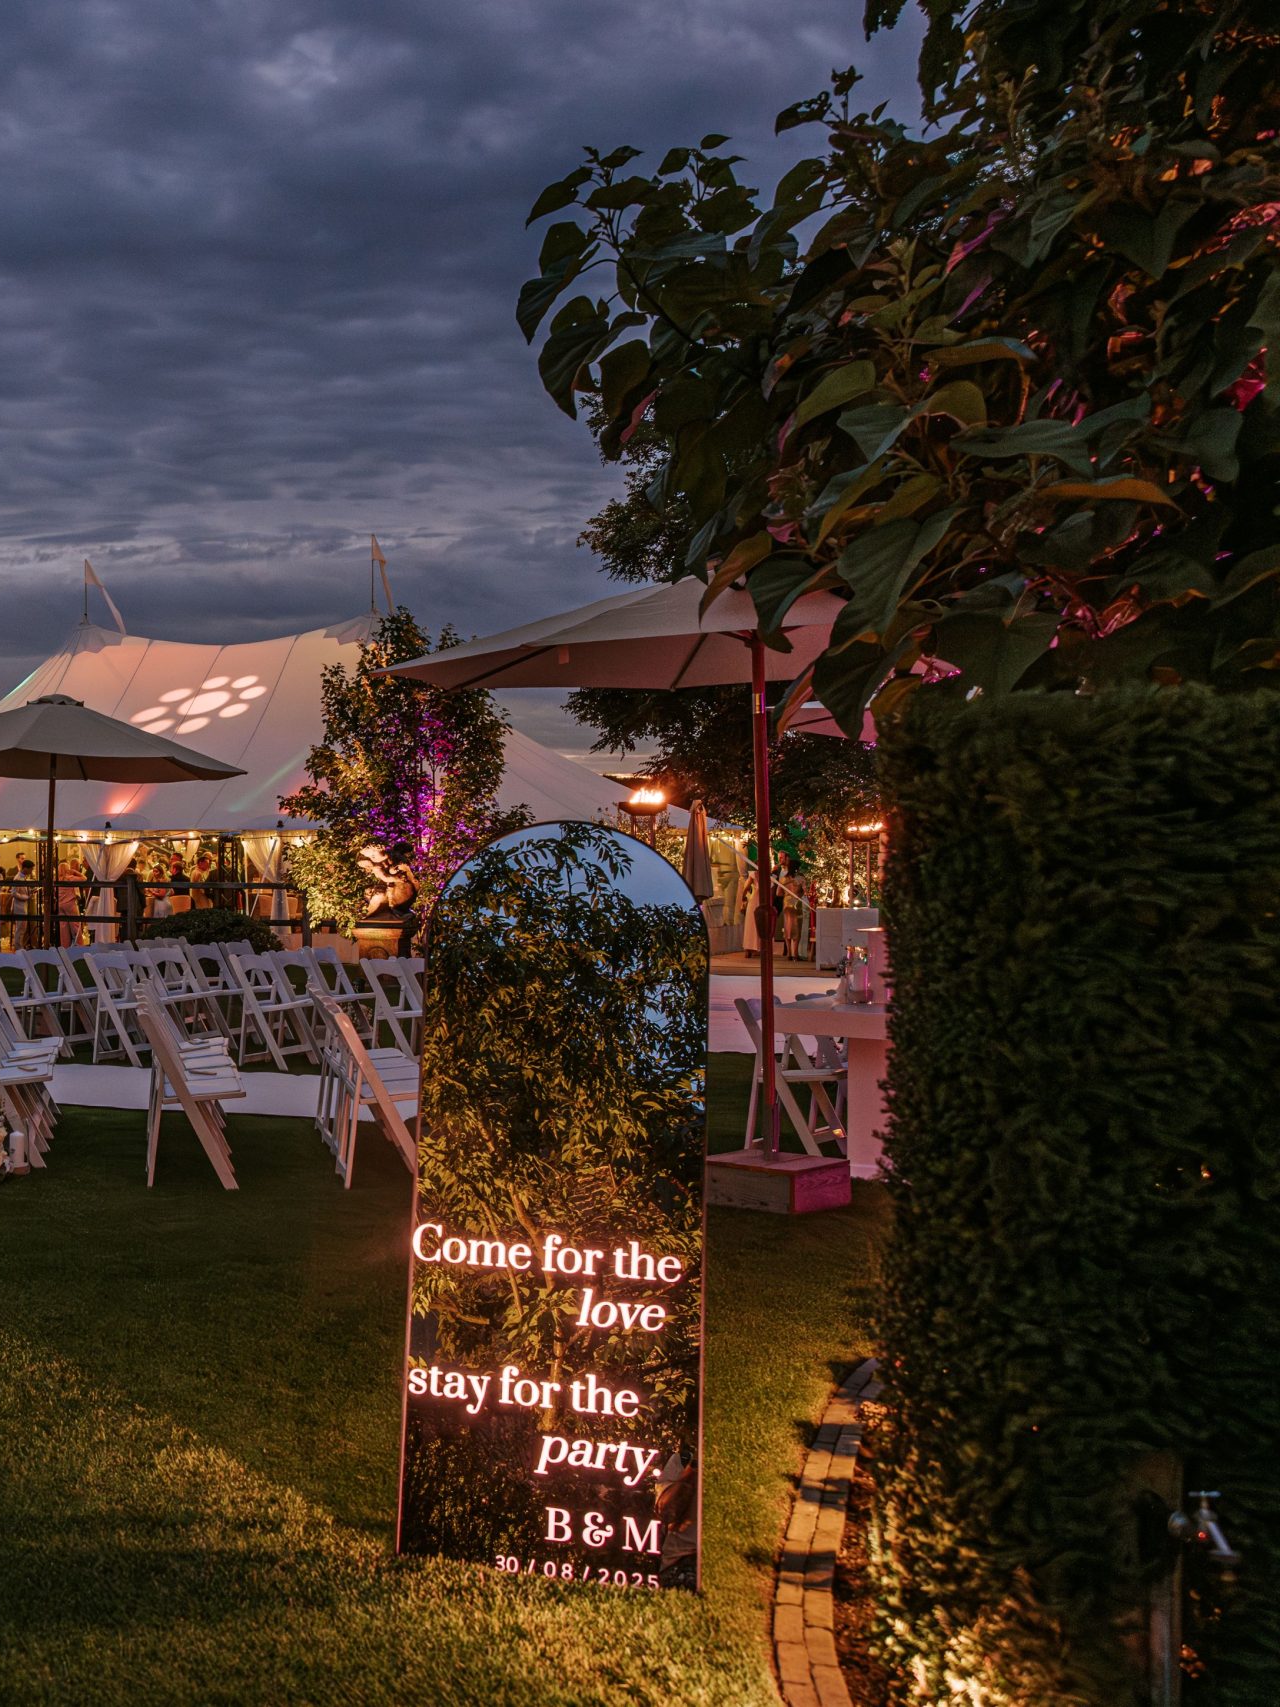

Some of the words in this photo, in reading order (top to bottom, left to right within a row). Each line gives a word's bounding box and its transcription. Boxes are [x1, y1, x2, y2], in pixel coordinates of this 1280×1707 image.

[411, 1221, 533, 1270] Come
[540, 1233, 605, 1276] for
[612, 1240, 682, 1283] the
[575, 1287, 666, 1332] love
[407, 1365, 491, 1415] stay
[498, 1365, 562, 1409] for
[569, 1373, 640, 1418] the
[533, 1435, 661, 1487] party.
[544, 1506, 573, 1542] B
[582, 1511, 614, 1547] &
[622, 1516, 662, 1555] M
